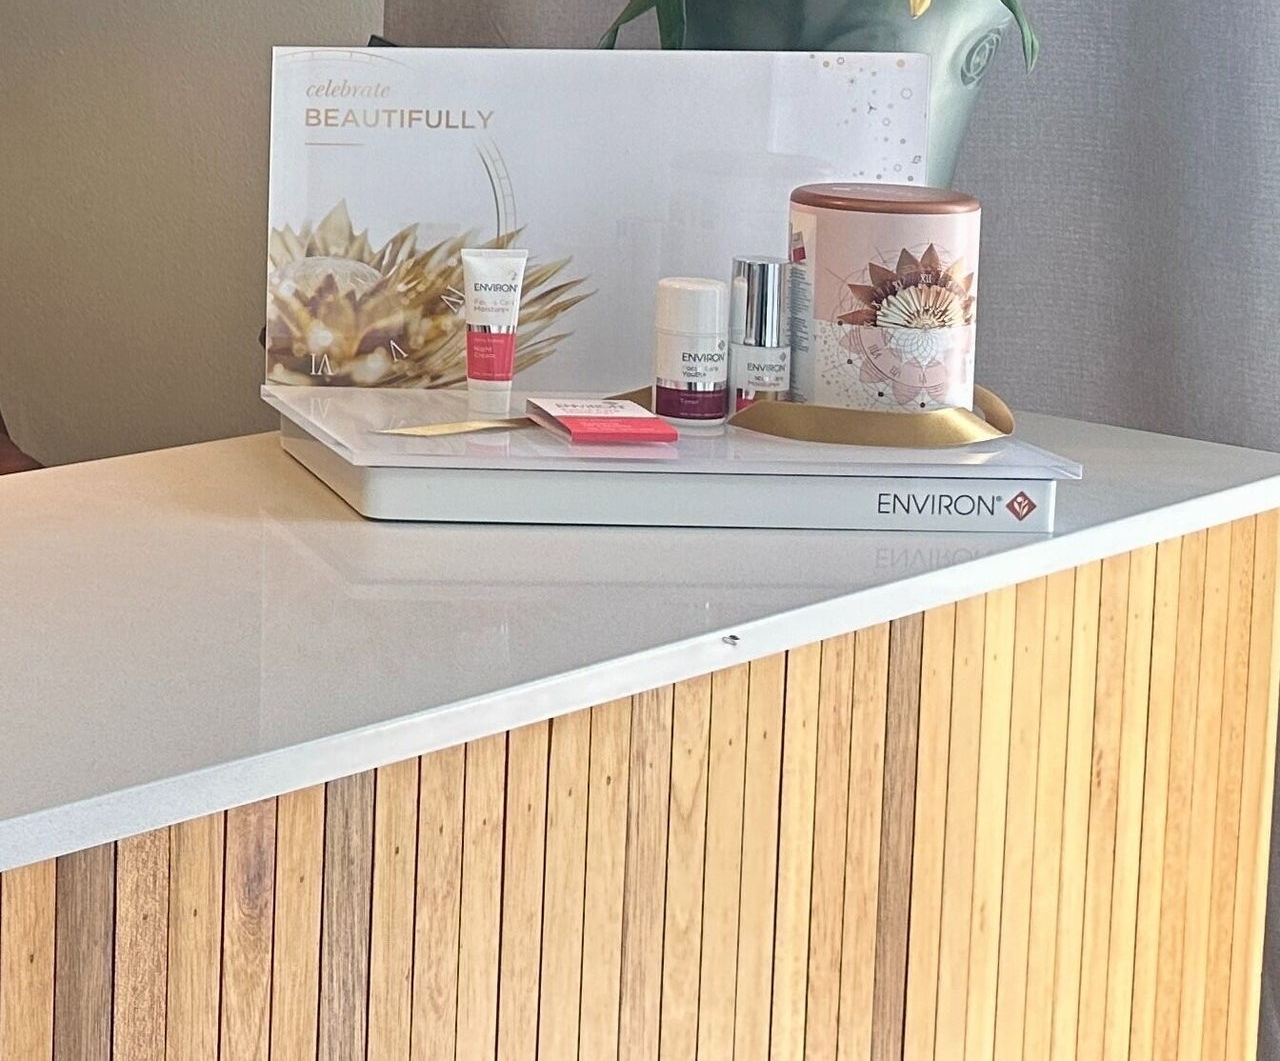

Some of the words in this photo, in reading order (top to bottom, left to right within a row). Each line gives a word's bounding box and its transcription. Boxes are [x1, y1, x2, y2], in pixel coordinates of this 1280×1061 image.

[306, 79, 391, 99] celebrate
[305, 108, 495, 129] BEAUTIFULLY
[474, 283, 518, 293] ENVIRON
[682, 352, 725, 363] ENVIRON
